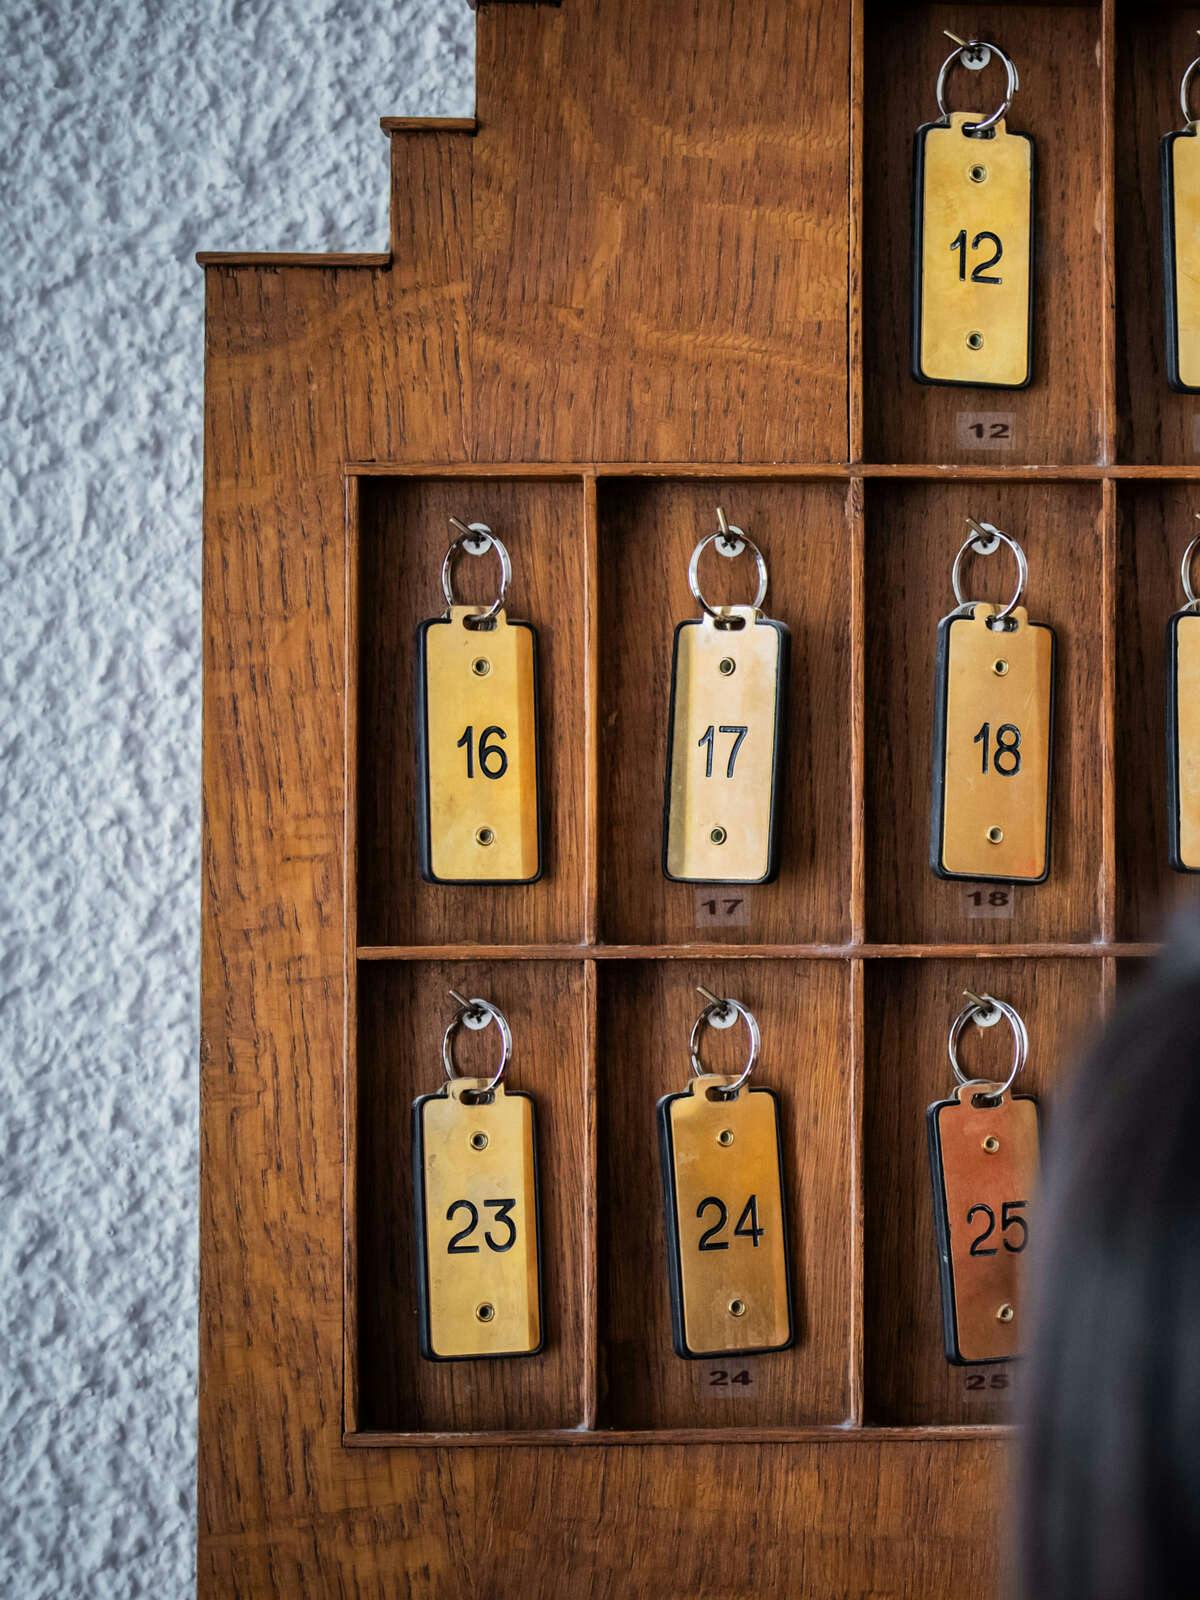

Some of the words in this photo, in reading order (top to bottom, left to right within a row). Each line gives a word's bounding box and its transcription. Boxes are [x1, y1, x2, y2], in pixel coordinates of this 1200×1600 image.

[949, 229, 1003, 285] 12
[967, 421, 1010, 440] 12
[456, 725, 510, 780] 16
[697, 725, 749, 778] 17
[973, 721, 1022, 777] 18
[700, 897, 743, 916] 17
[966, 891, 1010, 908] 18
[445, 1197, 518, 1255] 23
[695, 1194, 765, 1252] 24
[966, 1200, 1030, 1258] 25
[708, 1370, 753, 1387] 24
[965, 1373, 1010, 1391] 25
